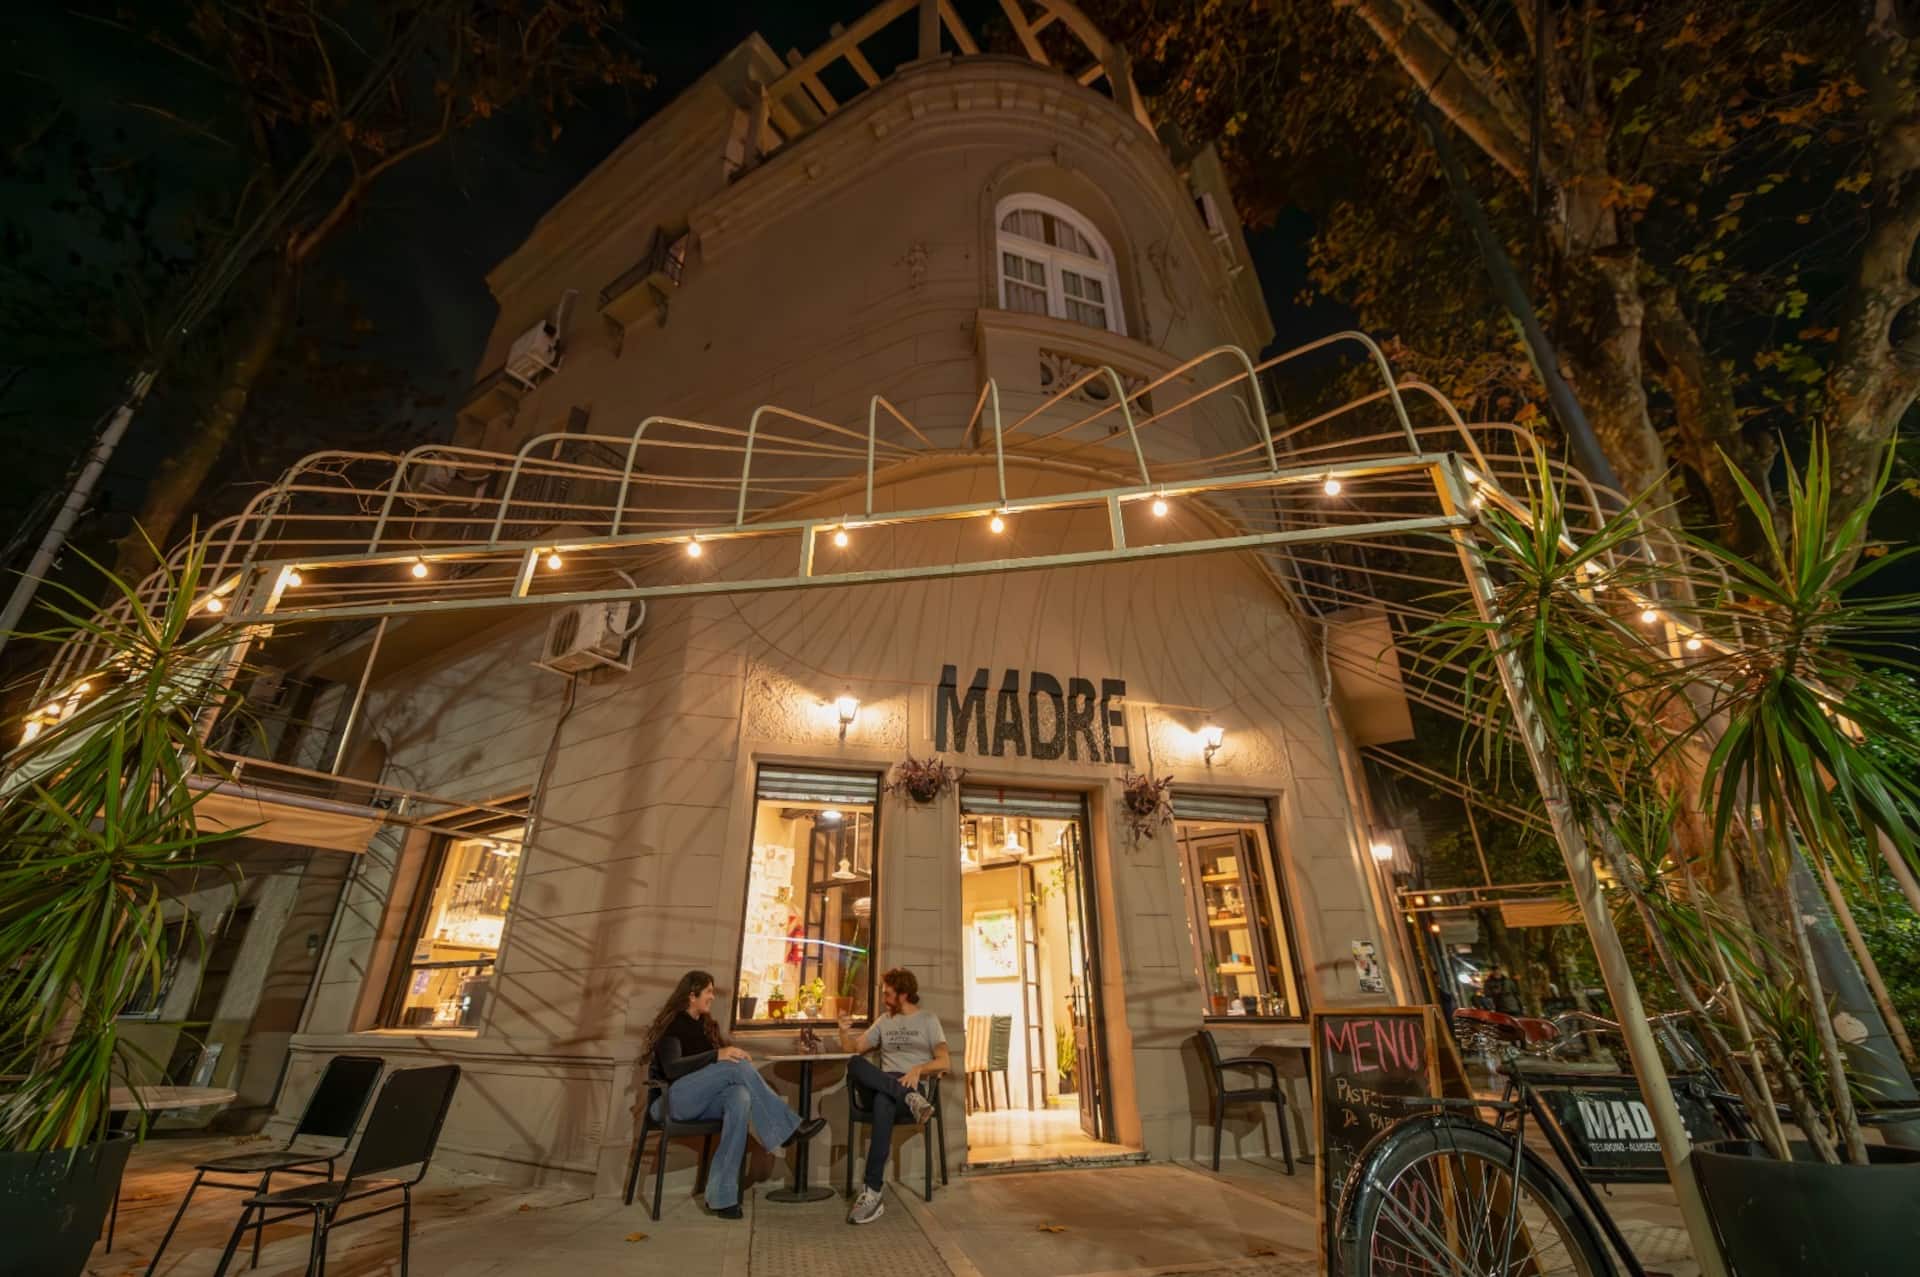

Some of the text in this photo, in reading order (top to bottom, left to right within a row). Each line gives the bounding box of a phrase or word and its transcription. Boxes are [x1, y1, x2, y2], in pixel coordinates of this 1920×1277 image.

[936, 664, 1130, 764] MADRE
[1324, 1018, 1418, 1072] MENU
[1577, 1101, 1693, 1139] MAD
